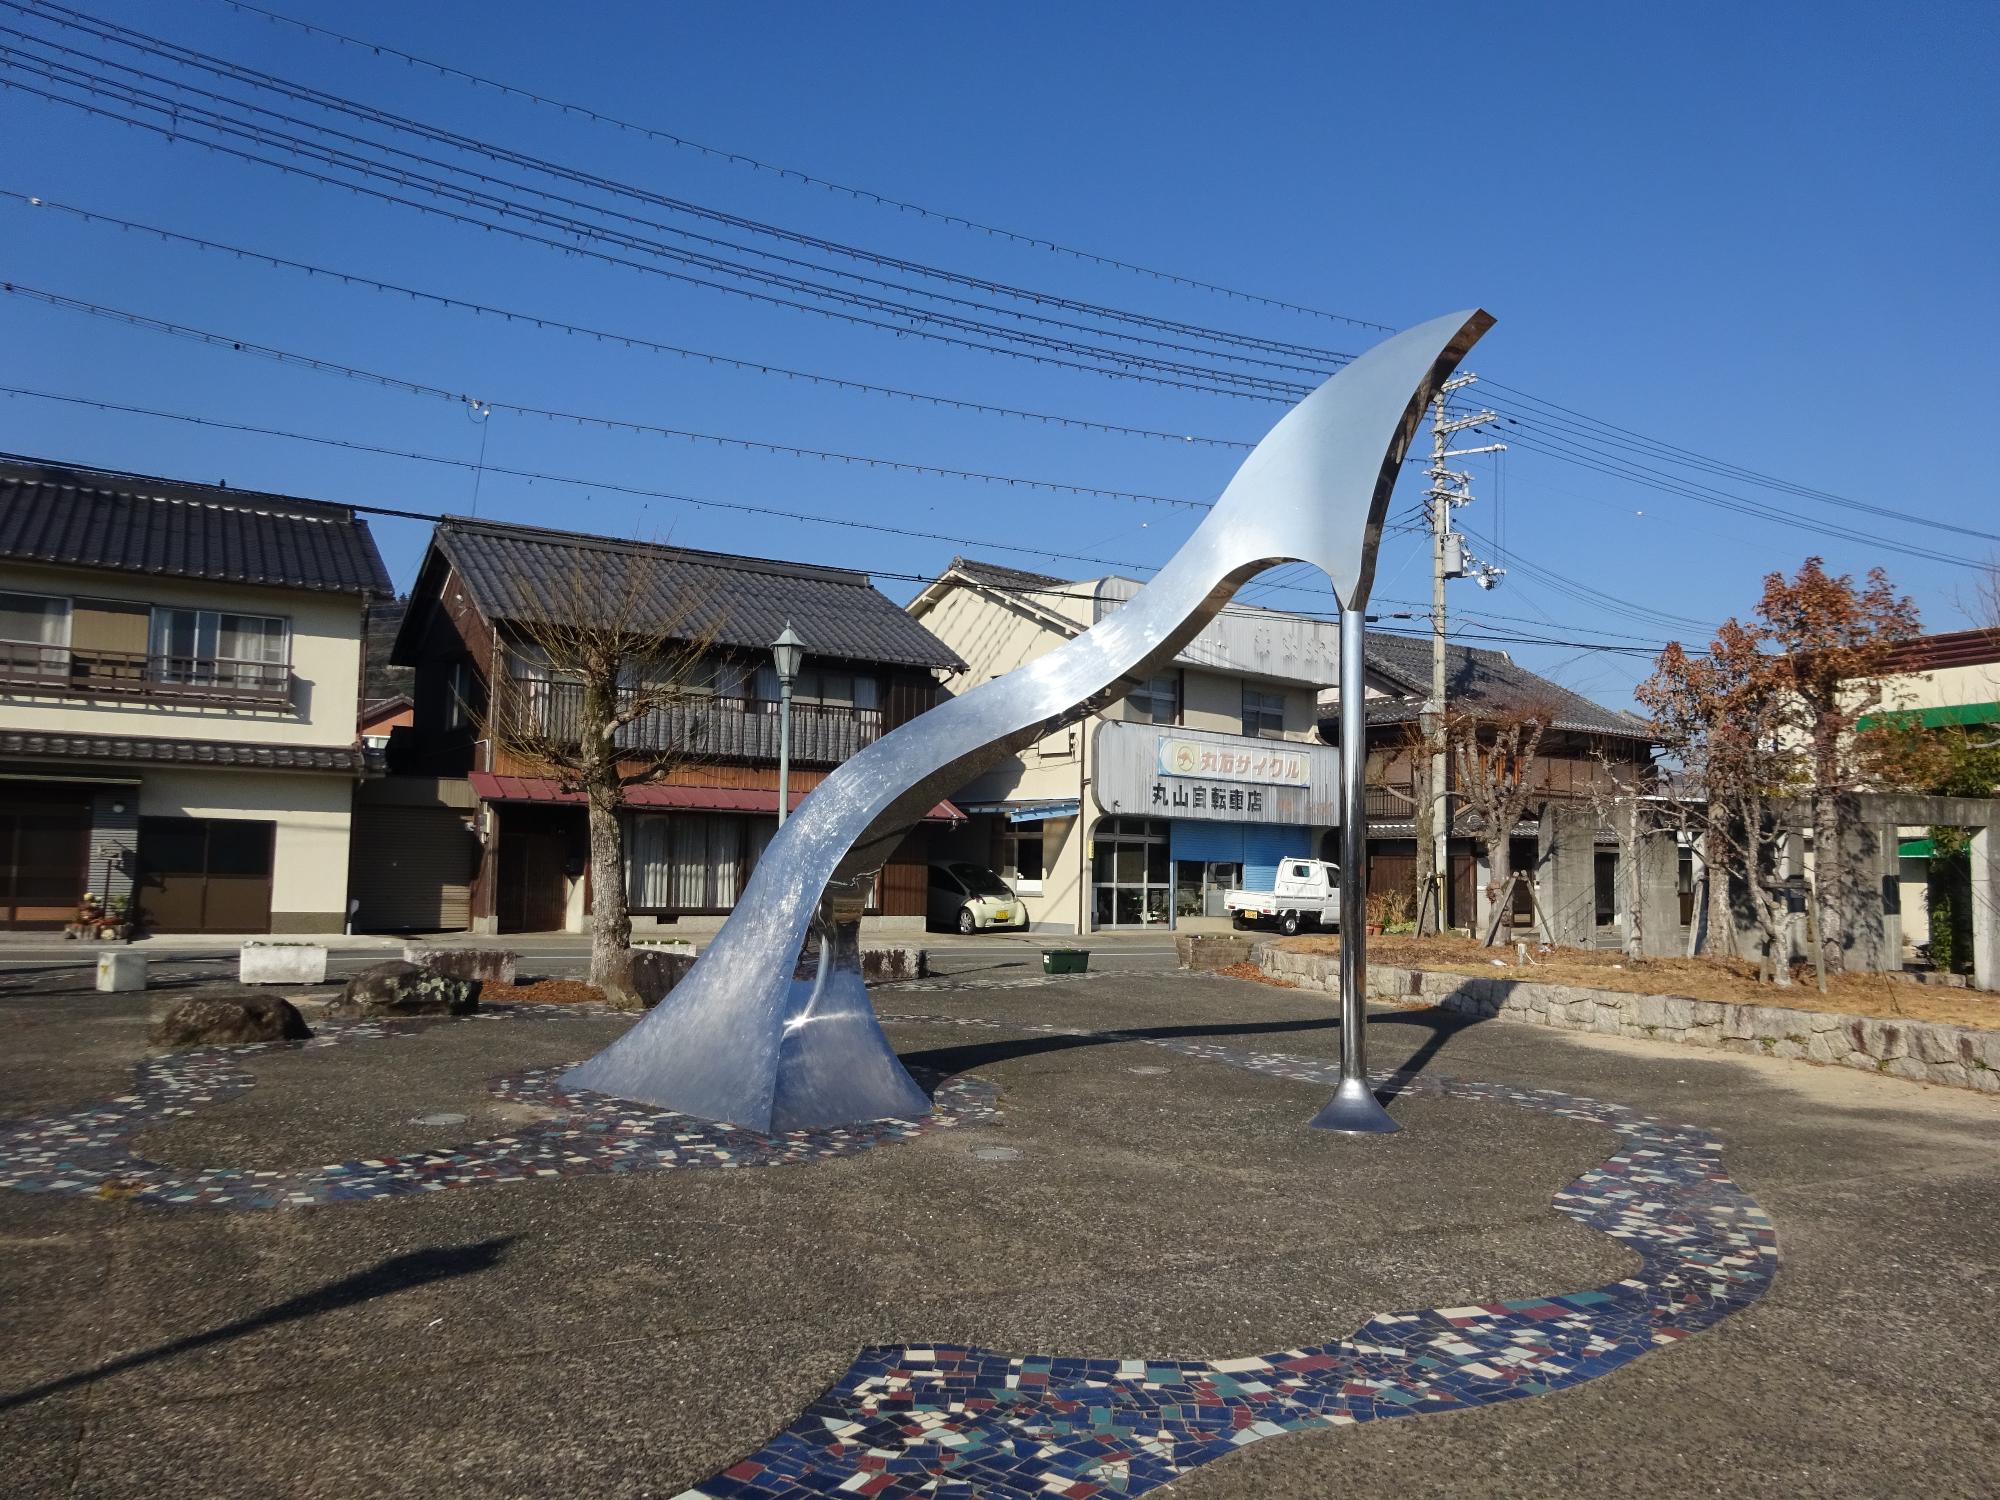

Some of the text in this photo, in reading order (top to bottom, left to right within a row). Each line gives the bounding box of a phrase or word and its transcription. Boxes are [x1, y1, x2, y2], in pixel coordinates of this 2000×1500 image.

[1200, 751, 1300, 779] 丸石サイクル
[1152, 782, 1262, 812] 丸山自転車店
